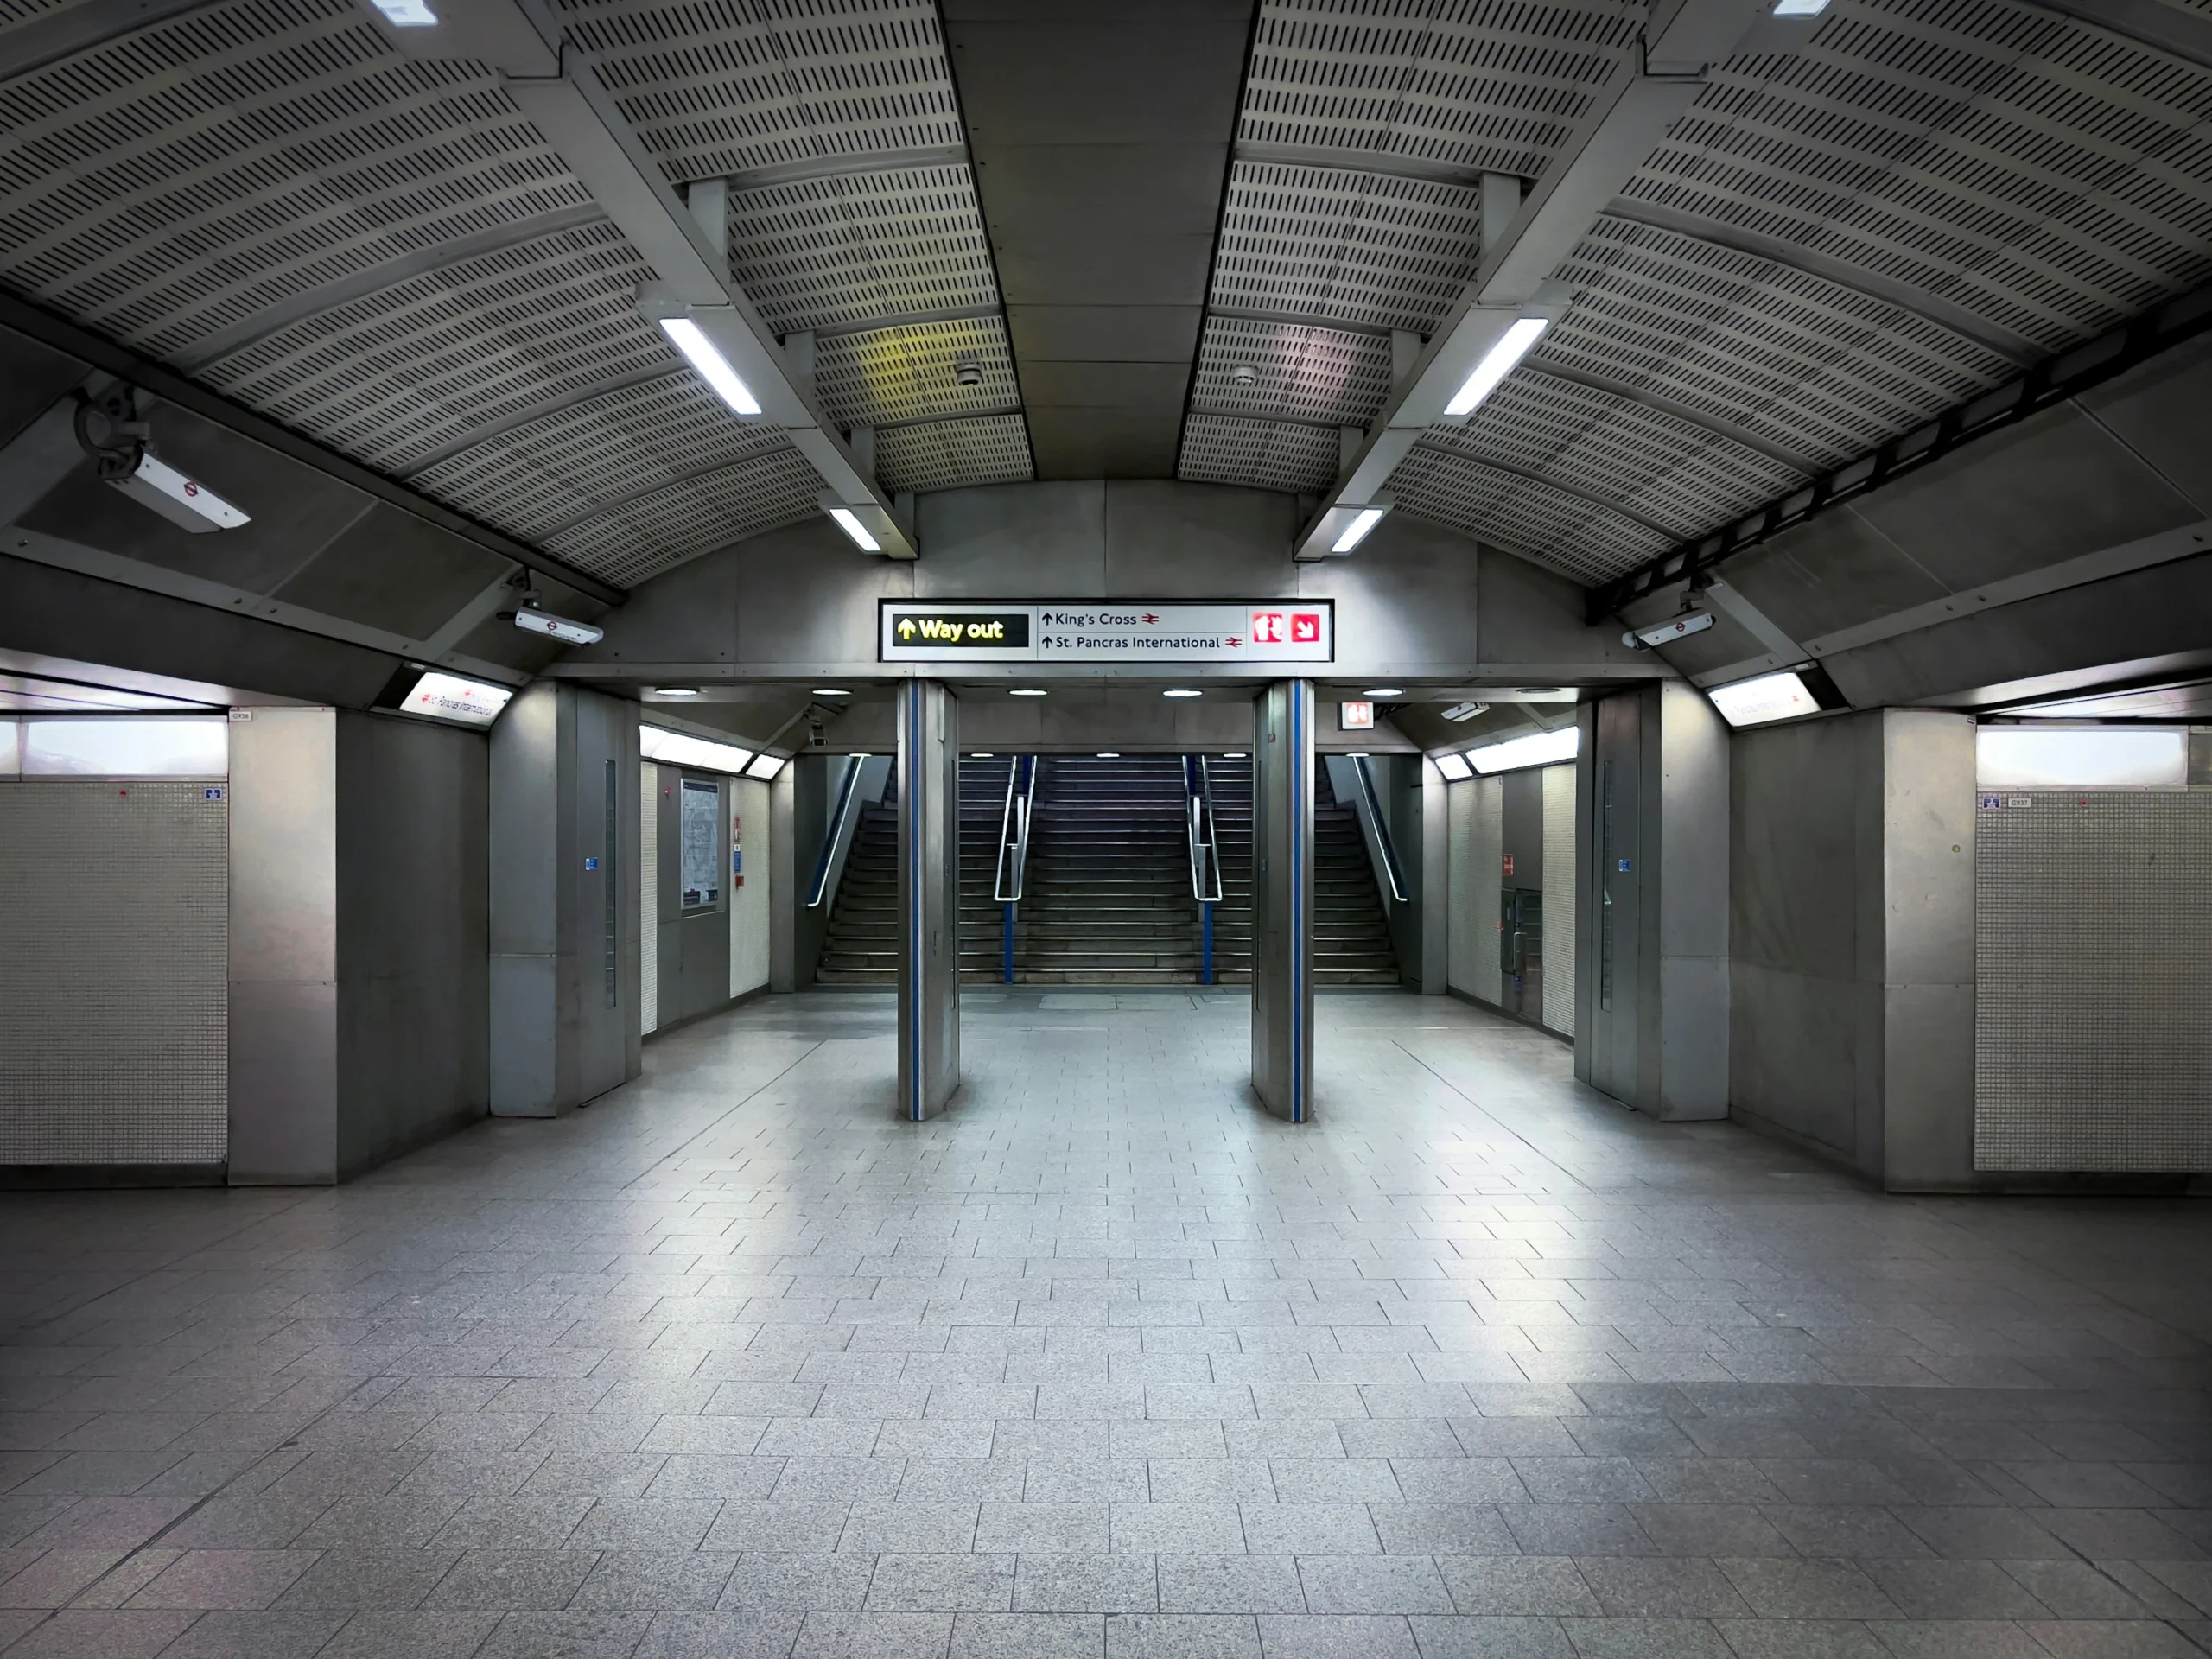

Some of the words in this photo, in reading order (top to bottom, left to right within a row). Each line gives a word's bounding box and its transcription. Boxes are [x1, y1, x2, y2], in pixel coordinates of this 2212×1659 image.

[1055, 613, 1095, 627] King's
[1098, 613, 1137, 626] Cross
[918, 619, 963, 642] Way
[967, 620, 1004, 639] out
[1055, 636, 1073, 648] St.
[1077, 636, 1128, 648] Pancras
[1133, 636, 1220, 648] International
